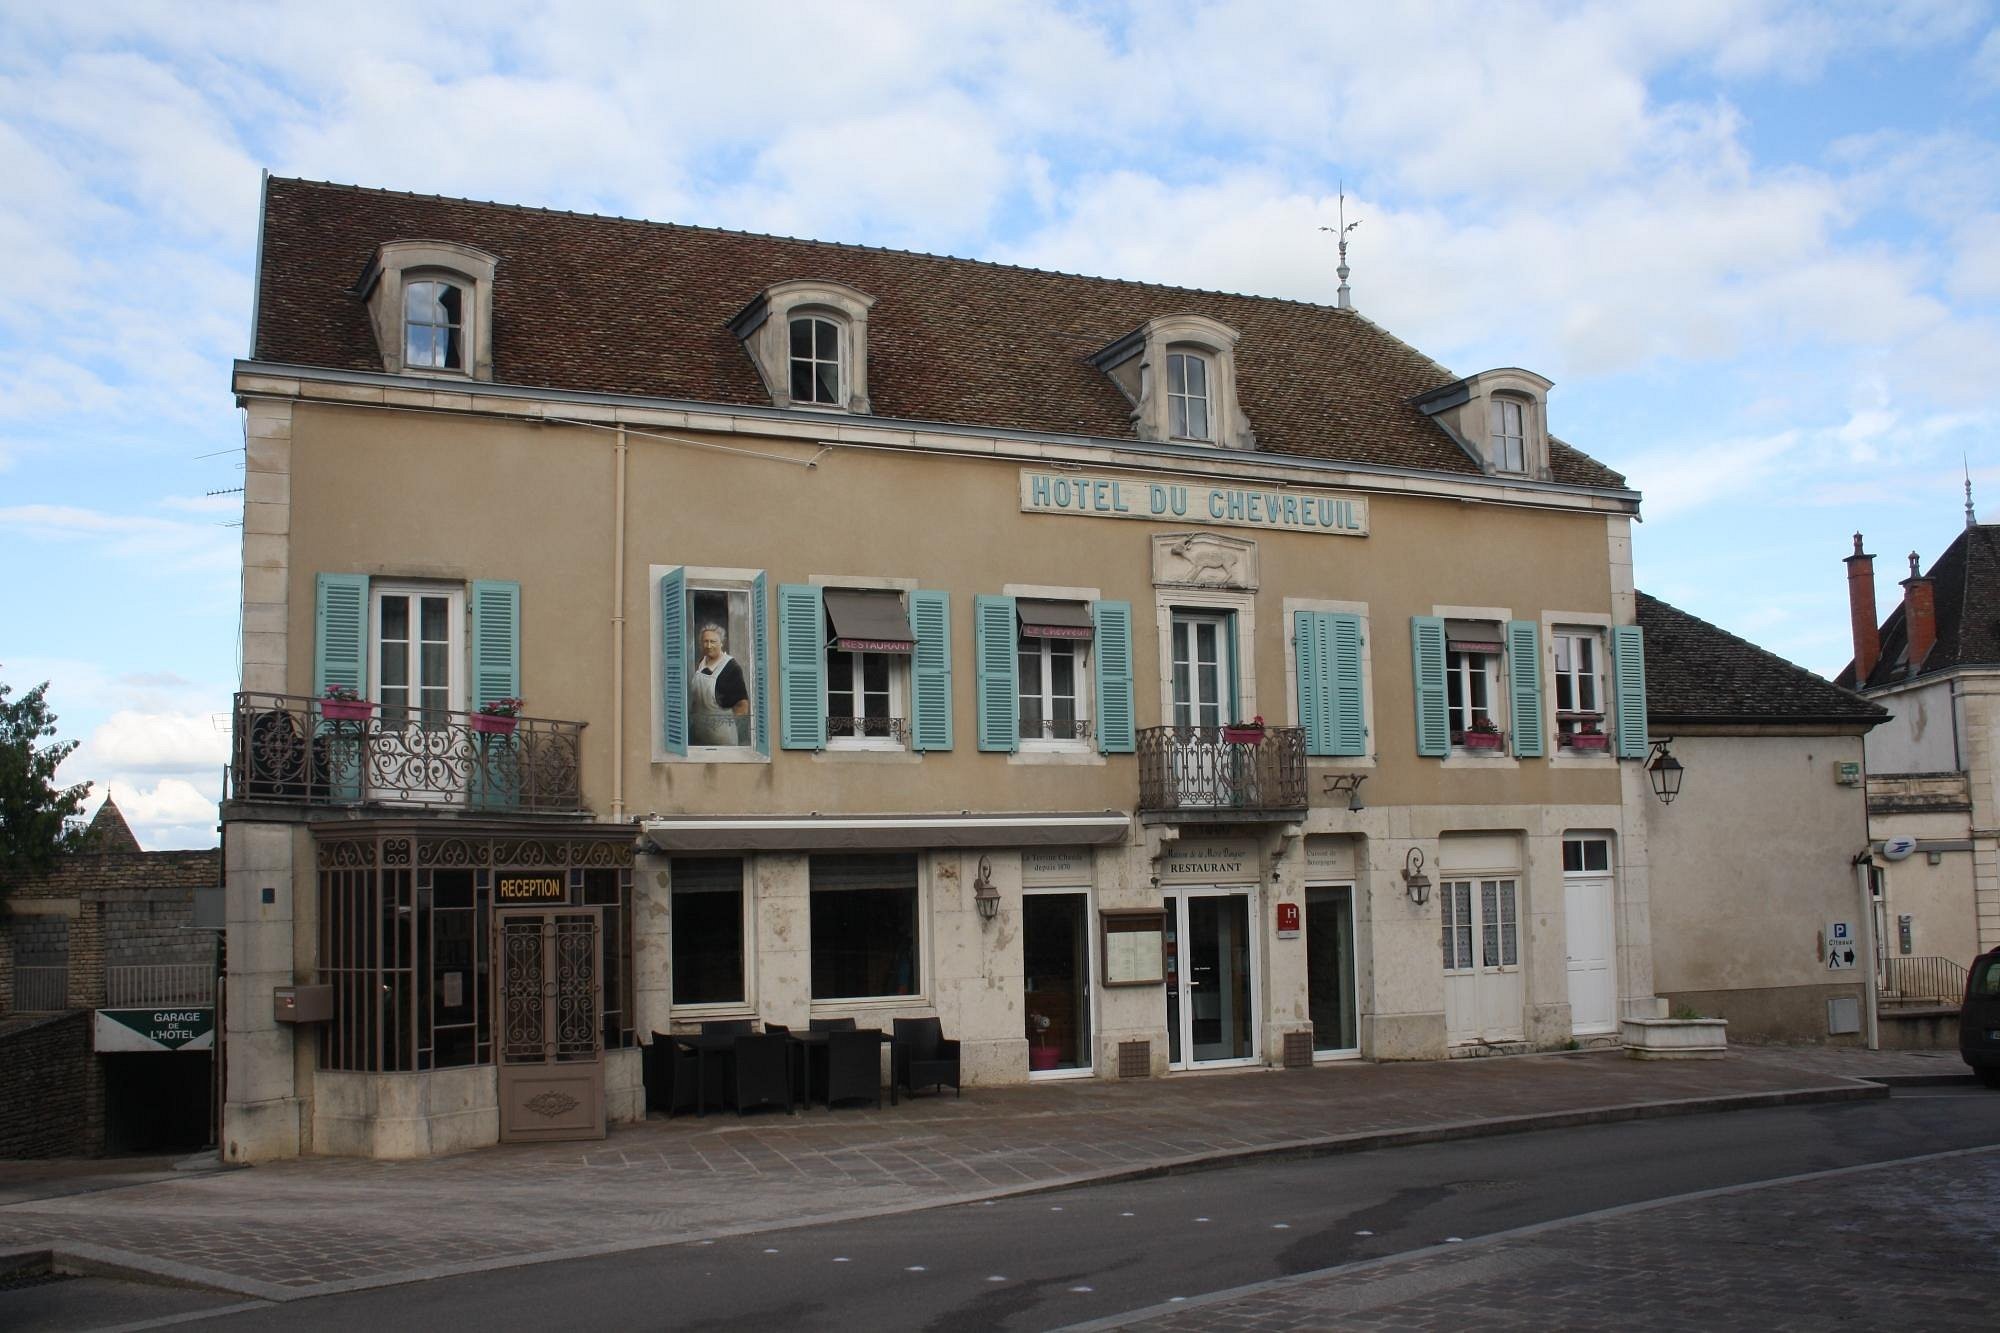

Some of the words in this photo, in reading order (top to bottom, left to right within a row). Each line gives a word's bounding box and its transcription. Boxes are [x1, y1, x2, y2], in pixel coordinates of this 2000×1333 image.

[1150, 484, 1187, 516] DU
[1208, 489, 1360, 530] CHEVREUIL
[841, 640, 910, 651] RESTAURANT
[1170, 862, 1242, 873] RESTAURANT
[501, 878, 560, 897] RECEPTION
[1287, 907, 1297, 919] H
[153, 1012, 201, 1023] GARAGE
[168, 1022, 180, 1030] DE
[150, 1030, 196, 1040] L'HOTEL
